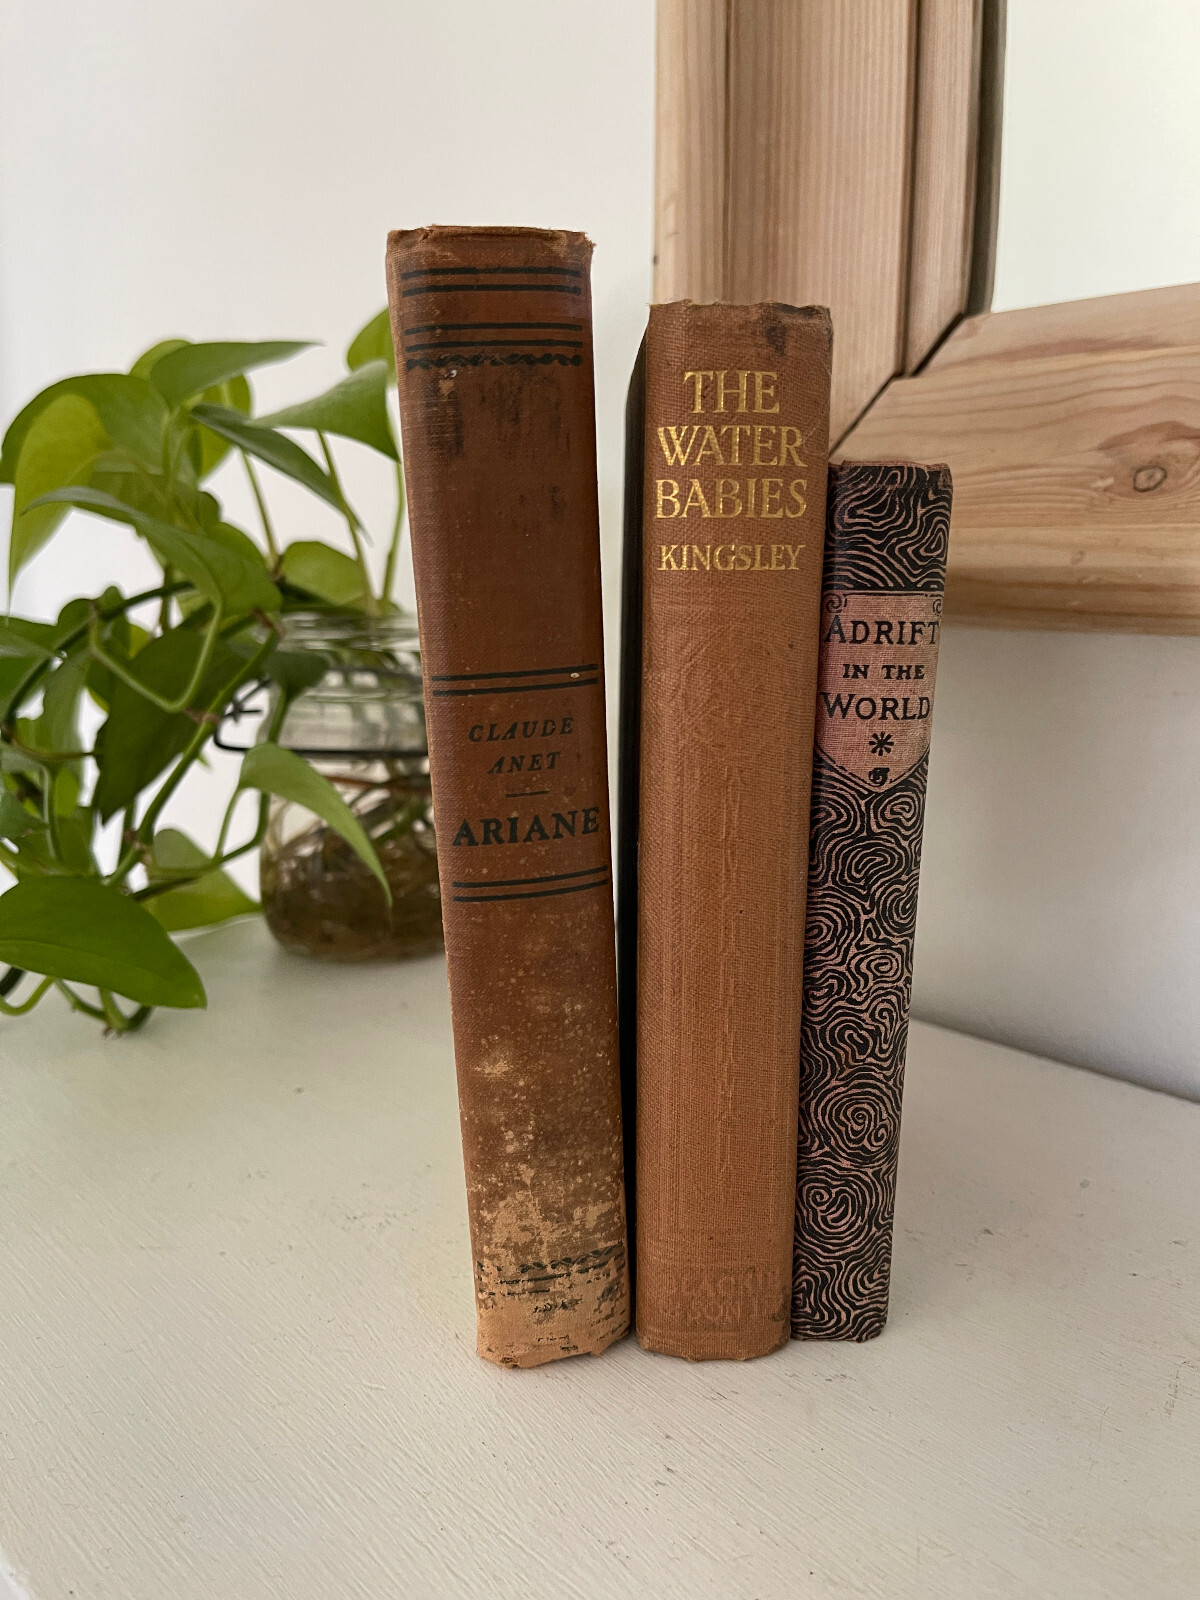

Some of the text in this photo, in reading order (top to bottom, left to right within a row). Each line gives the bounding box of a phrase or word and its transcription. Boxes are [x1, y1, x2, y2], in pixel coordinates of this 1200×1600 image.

[682, 370, 780, 414] THE
[656, 425, 808, 467] WATER
[654, 478, 808, 519] BABIES
[656, 544, 806, 571] KINGSLEY
[823, 615, 940, 646] ADRIFT
[842, 664, 925, 680] IN THE
[820, 691, 931, 721] WORLD
[468, 717, 574, 743] CLAUDE
[488, 751, 562, 774] ANET
[453, 807, 600, 847] ARIANE
